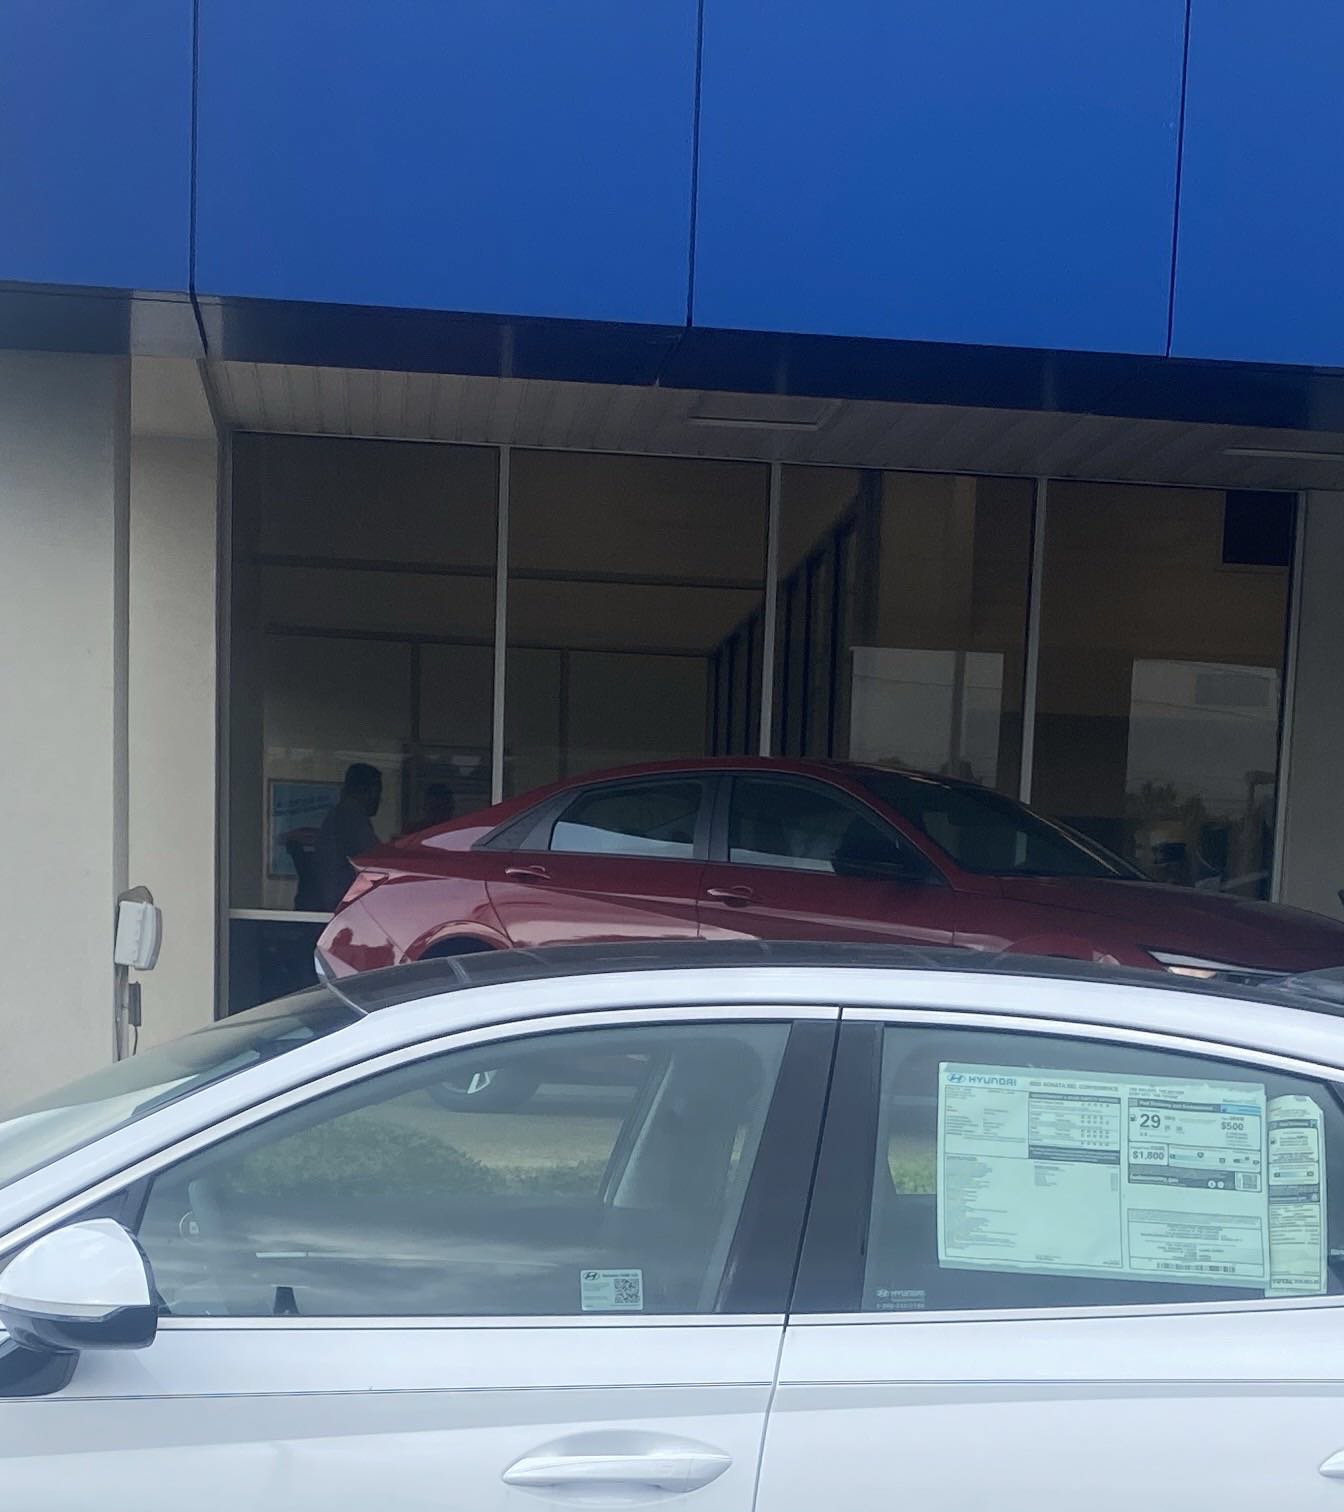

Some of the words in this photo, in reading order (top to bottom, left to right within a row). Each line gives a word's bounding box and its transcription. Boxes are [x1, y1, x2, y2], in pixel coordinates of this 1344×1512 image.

[969, 1075, 1017, 1087] HYUNDAI
[1139, 1113, 1161, 1129] 29
[1220, 1120, 1244, 1131] $500
